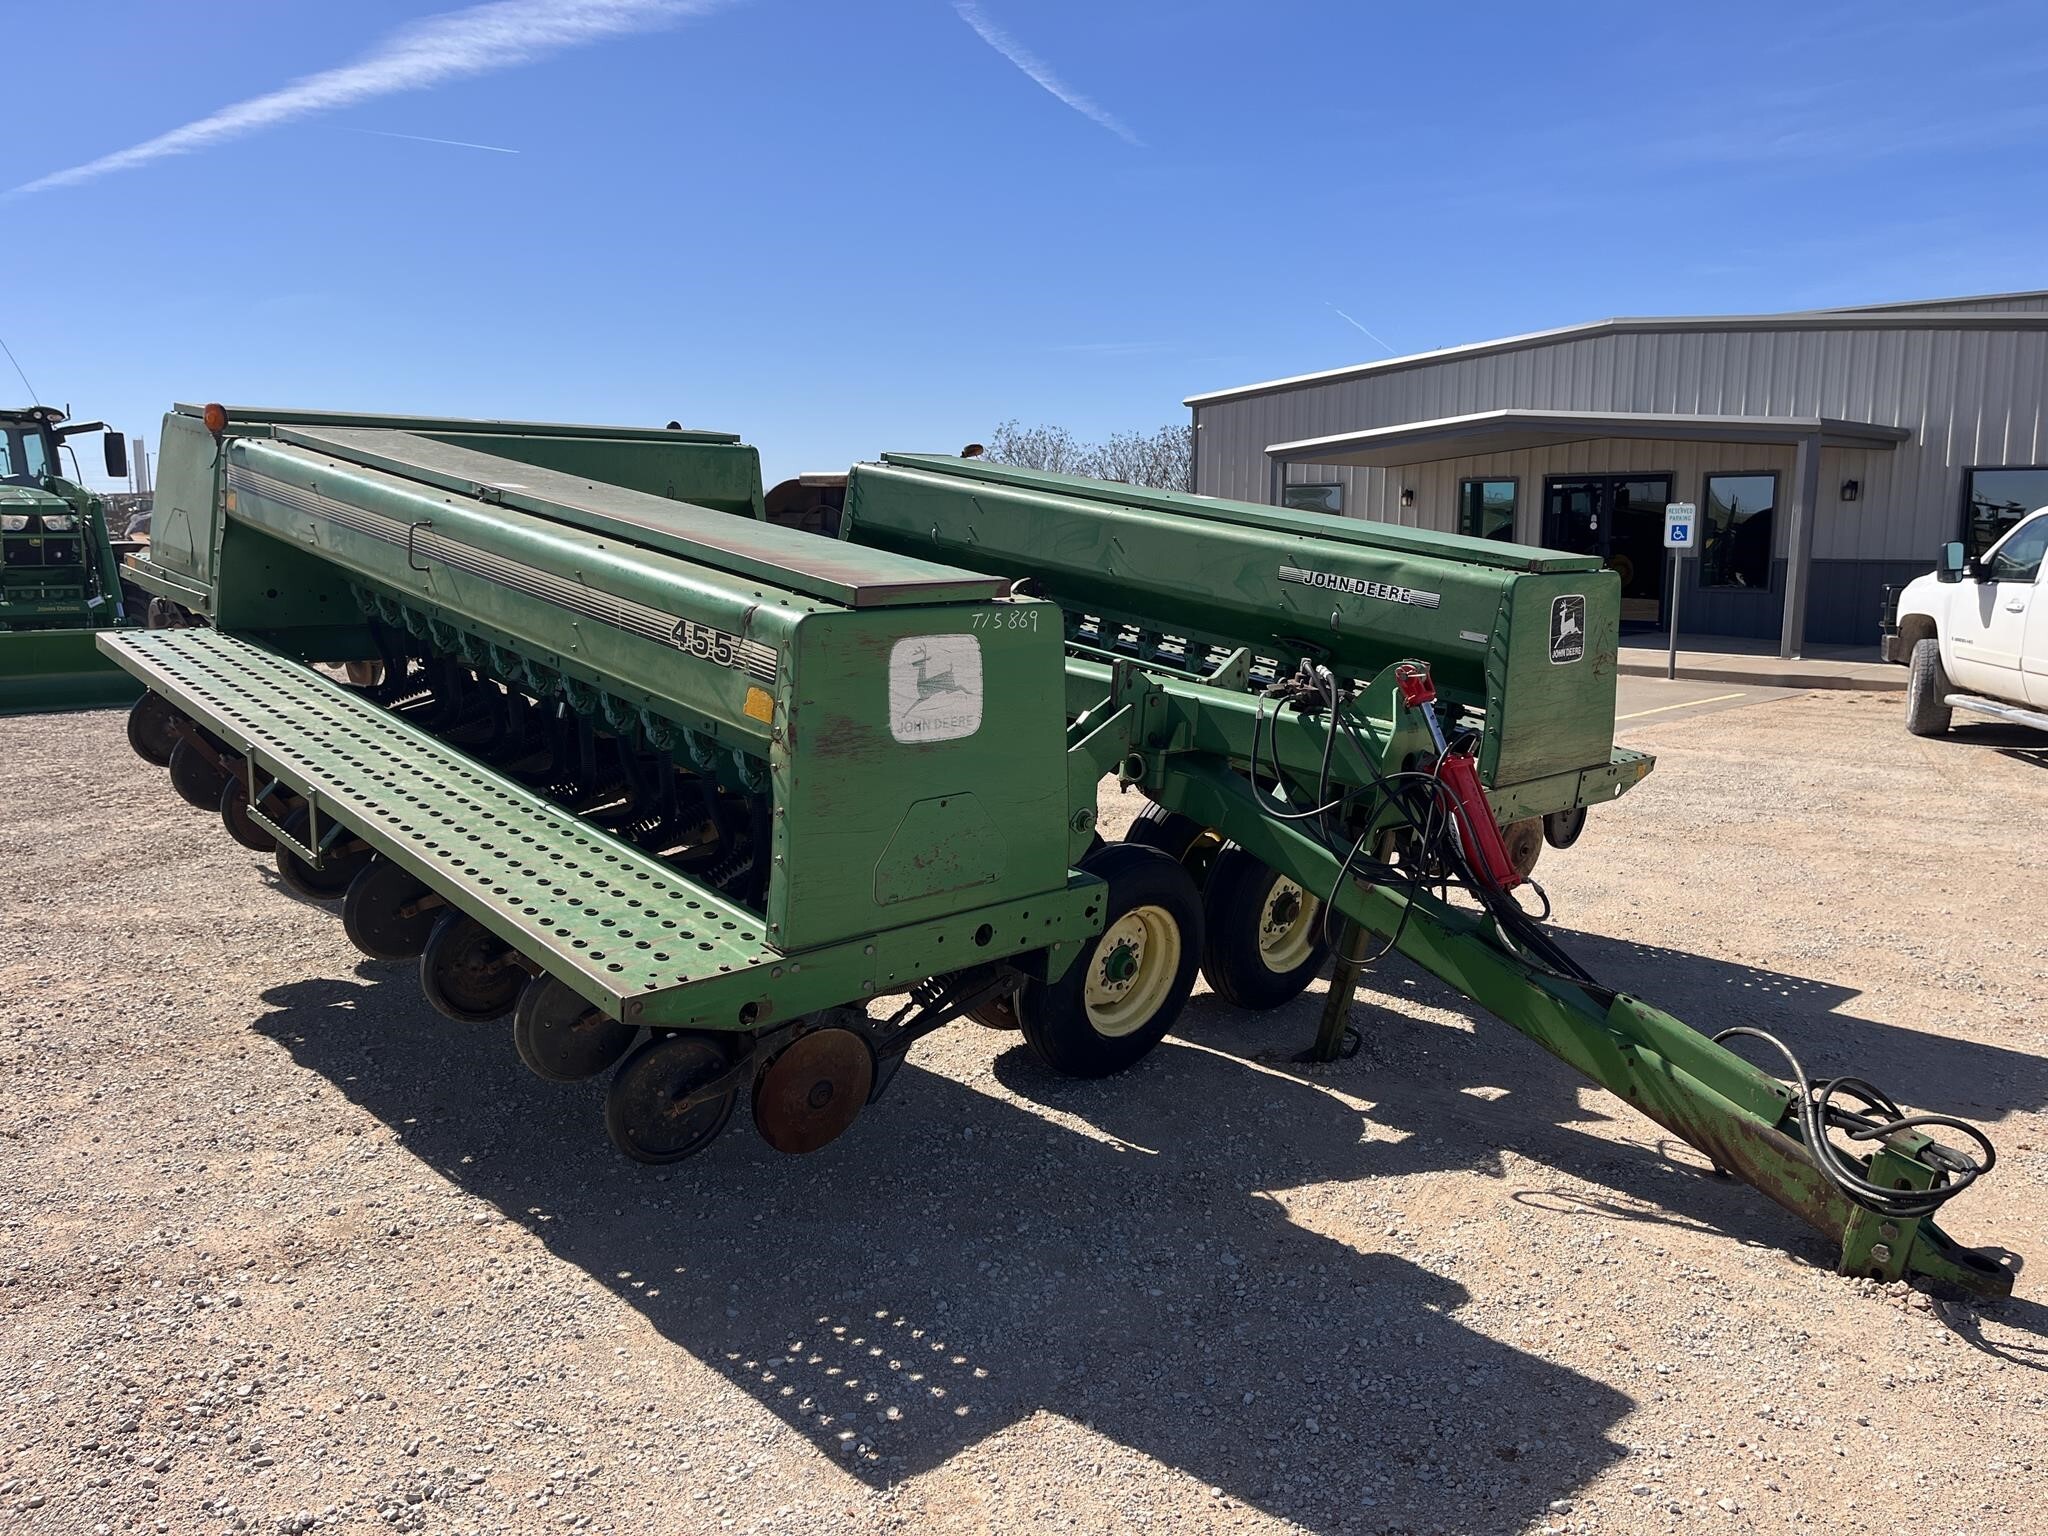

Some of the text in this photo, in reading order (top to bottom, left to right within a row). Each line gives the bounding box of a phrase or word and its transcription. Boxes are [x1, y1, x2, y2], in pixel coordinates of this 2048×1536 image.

[1303, 572, 1411, 602] JOHN DEERE
[670, 619, 733, 665] 455
[1552, 646, 1582, 658] JOHN DEERE
[897, 715, 974, 733] JOHN DEERE
